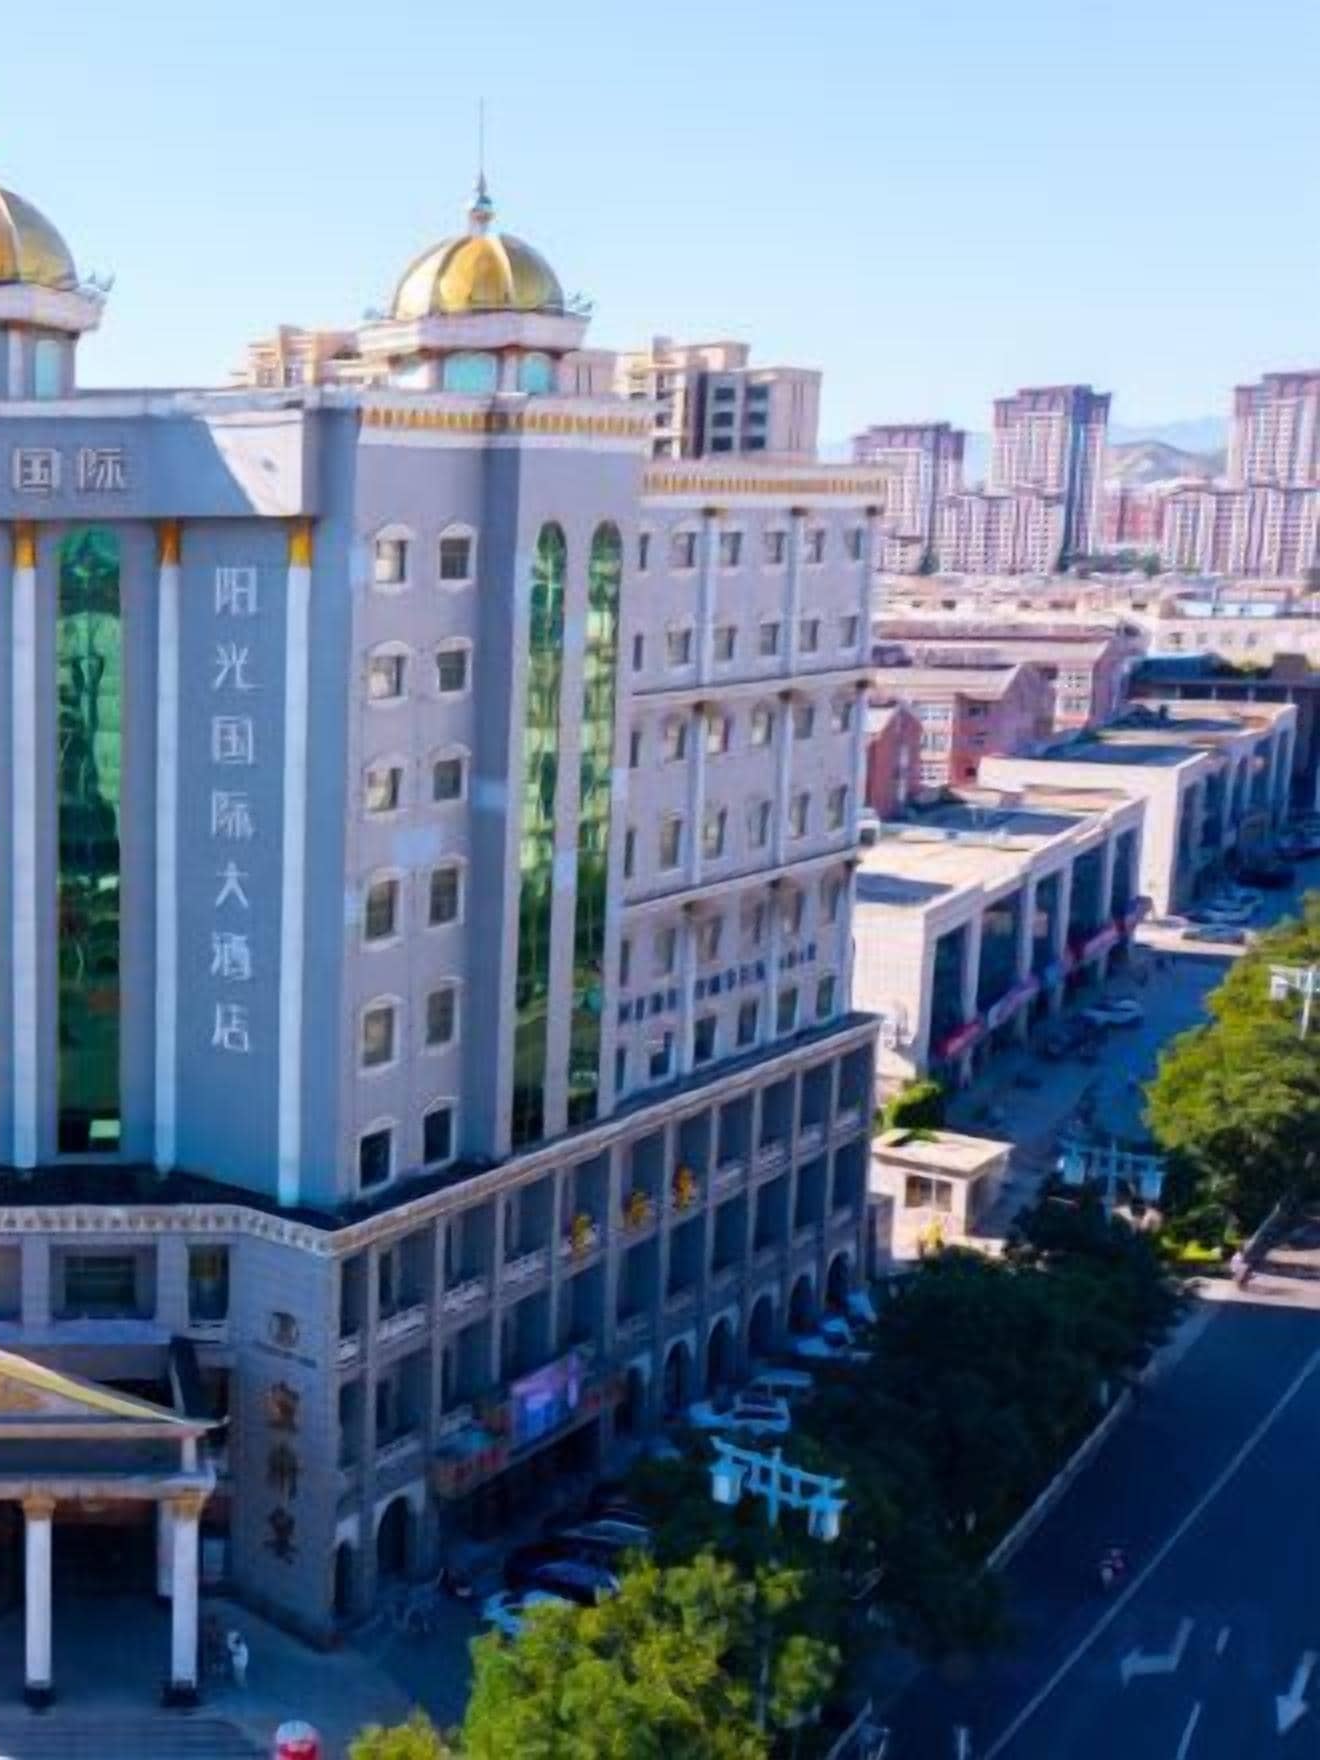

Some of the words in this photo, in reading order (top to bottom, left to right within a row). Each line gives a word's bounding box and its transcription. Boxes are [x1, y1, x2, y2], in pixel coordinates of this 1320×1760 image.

[210, 566, 261, 1054] 阳光国际大酒店
